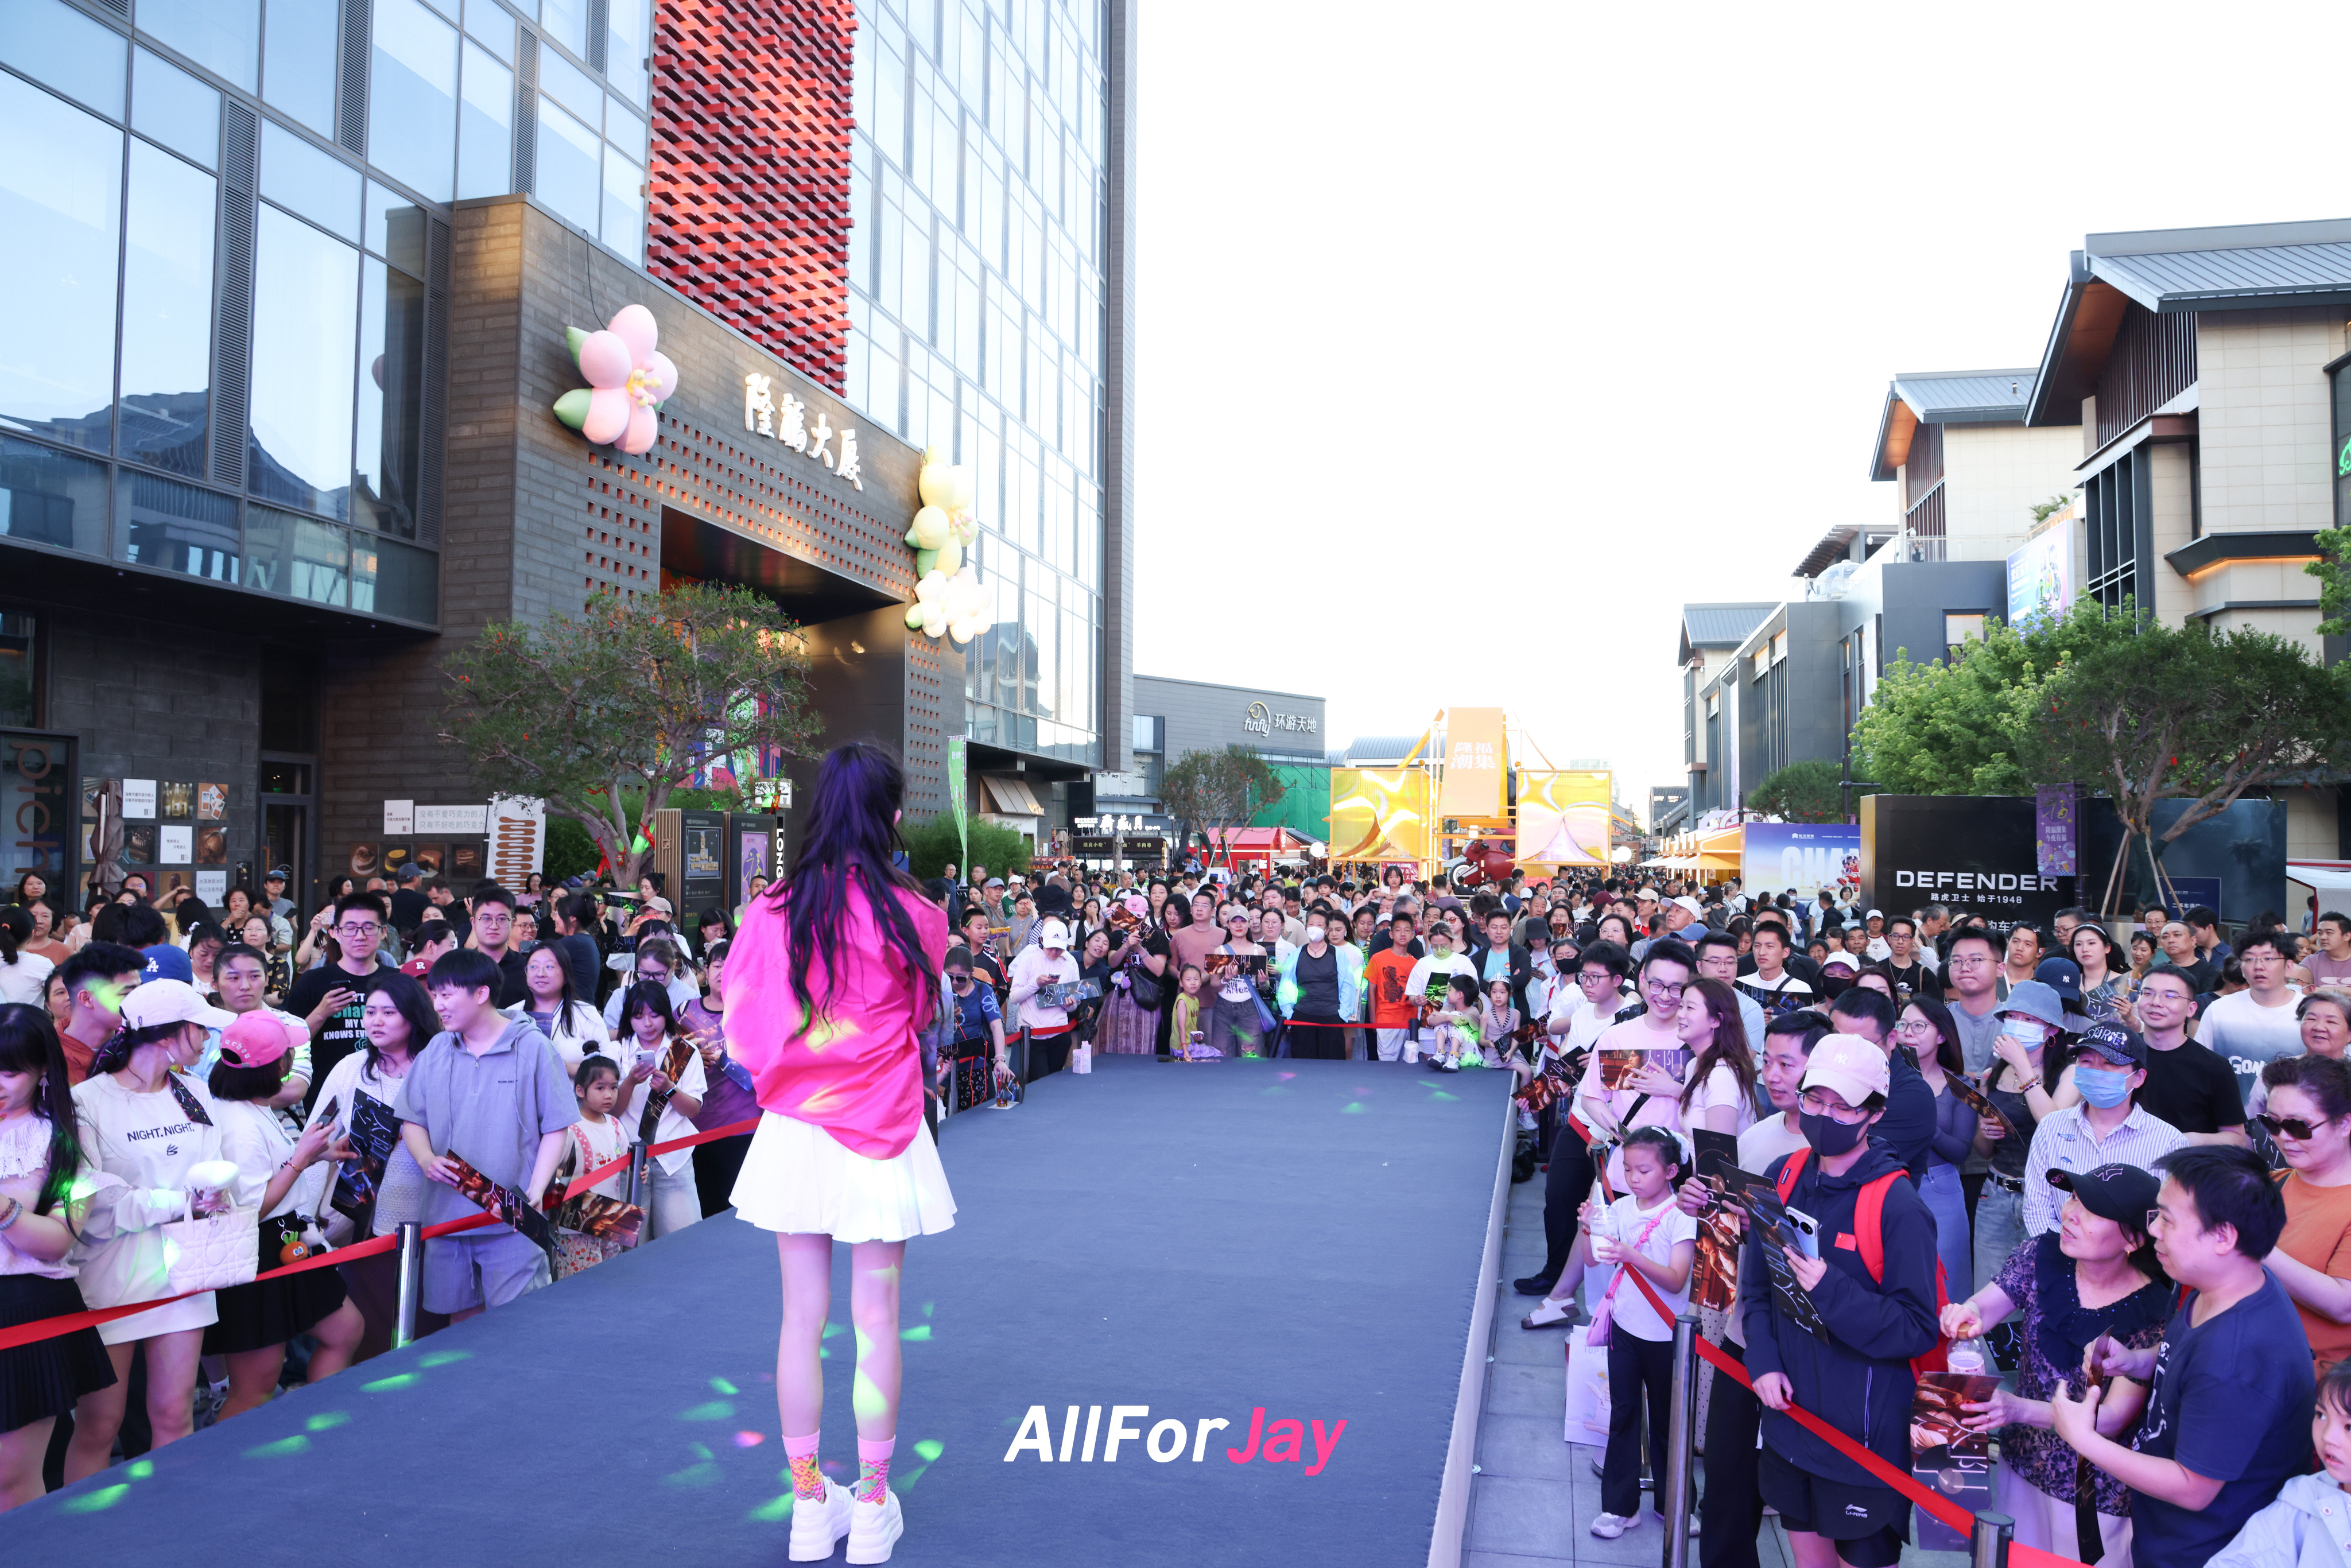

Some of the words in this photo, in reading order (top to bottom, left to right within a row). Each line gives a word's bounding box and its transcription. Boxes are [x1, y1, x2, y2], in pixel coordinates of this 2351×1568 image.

[1244, 717, 1270, 737] funfly
[1274, 713, 1317, 732] 环游天地
[1453, 742, 1493, 754] 隆福
[1450, 754, 1496, 770] 潮集
[420, 810, 486, 818] 没有不爱巧克力的人
[420, 821, 486, 829] 只有不好吃的巧克力
[1896, 870, 2058, 891] DEFENDER
[1930, 892, 1970, 902] 路虎卫士
[1977, 894, 2023, 904] 始于1948
[146, 957, 159, 972] LA
[416, 961, 426, 970] R
[345, 1018, 359, 1028] MY
[323, 1029, 354, 1041] KNOWS
[1833, 1053, 1848, 1065] NY
[1845, 1510, 1868, 1519] LI-NING
